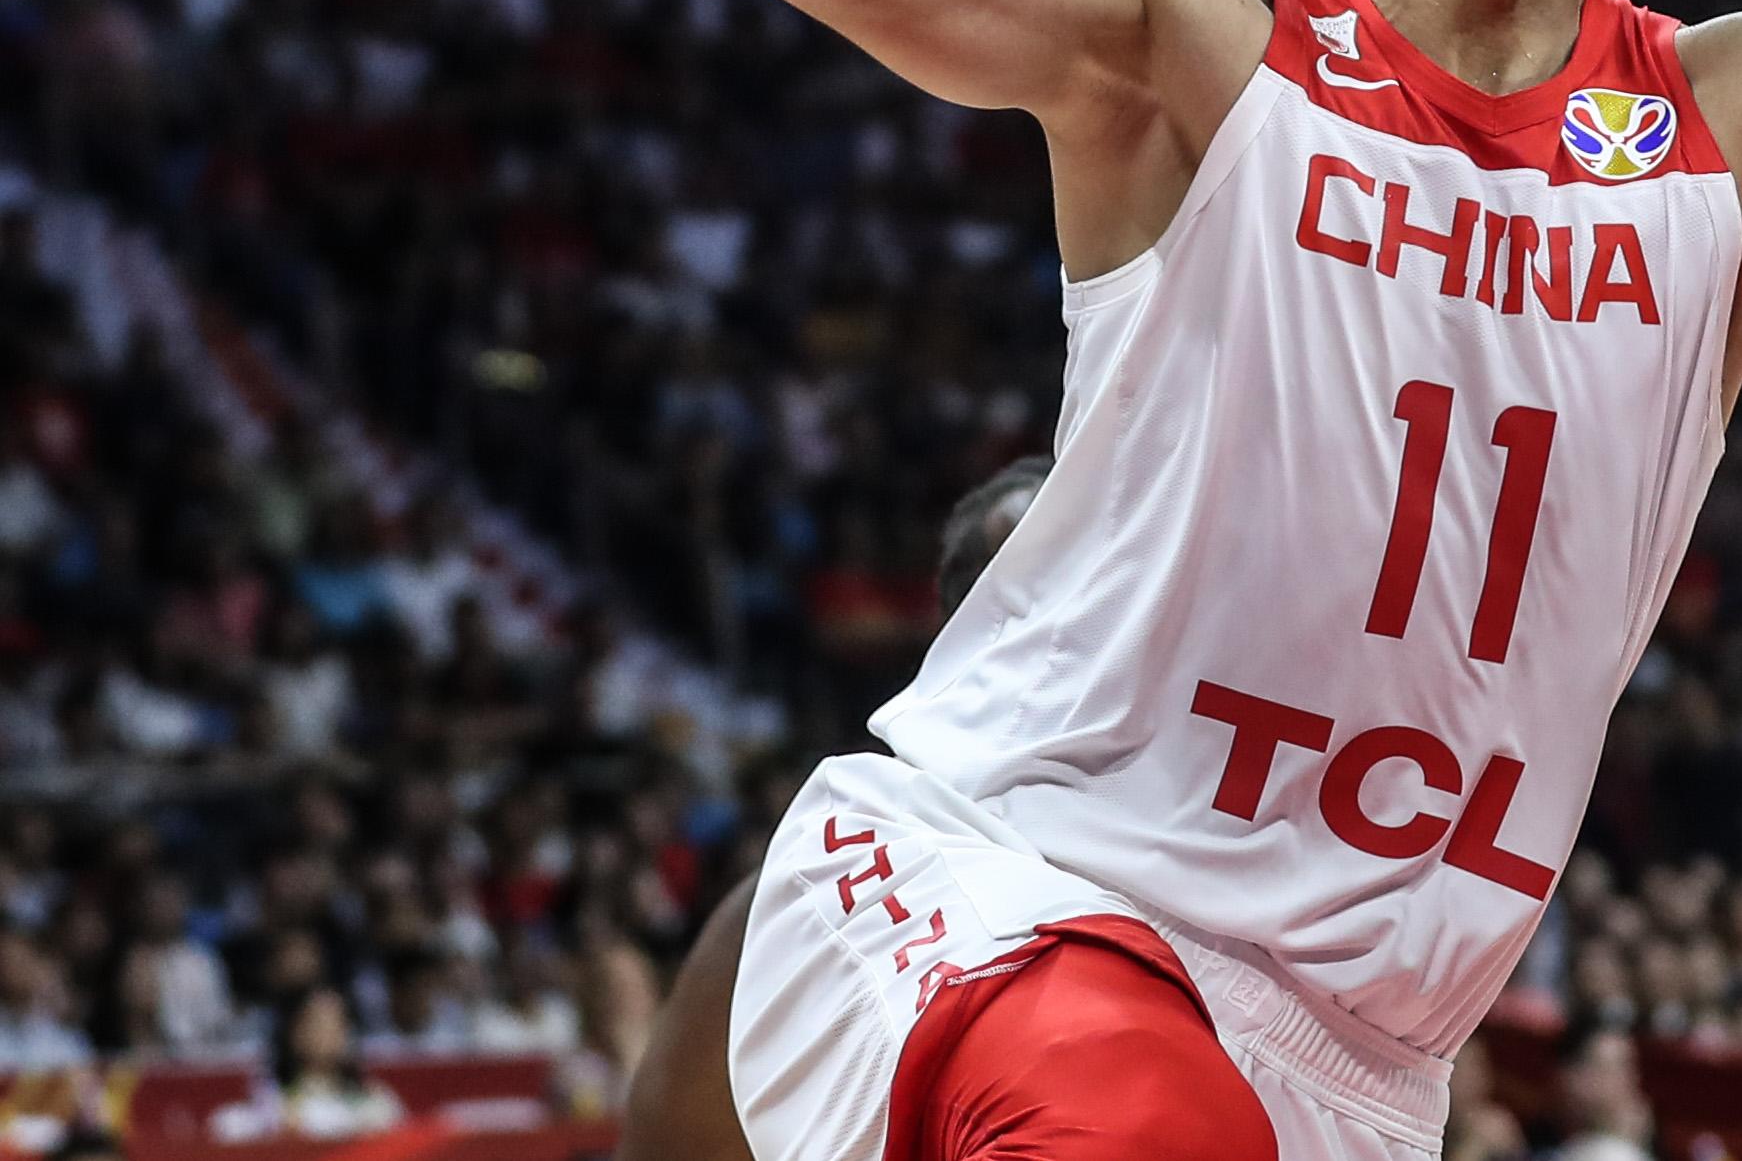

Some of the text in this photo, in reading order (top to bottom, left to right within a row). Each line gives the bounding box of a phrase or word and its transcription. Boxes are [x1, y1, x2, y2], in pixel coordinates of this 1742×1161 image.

[1296, 153, 1661, 325] CHINA
[1365, 379, 1557, 664] 11
[1190, 680, 1556, 901] TCL
